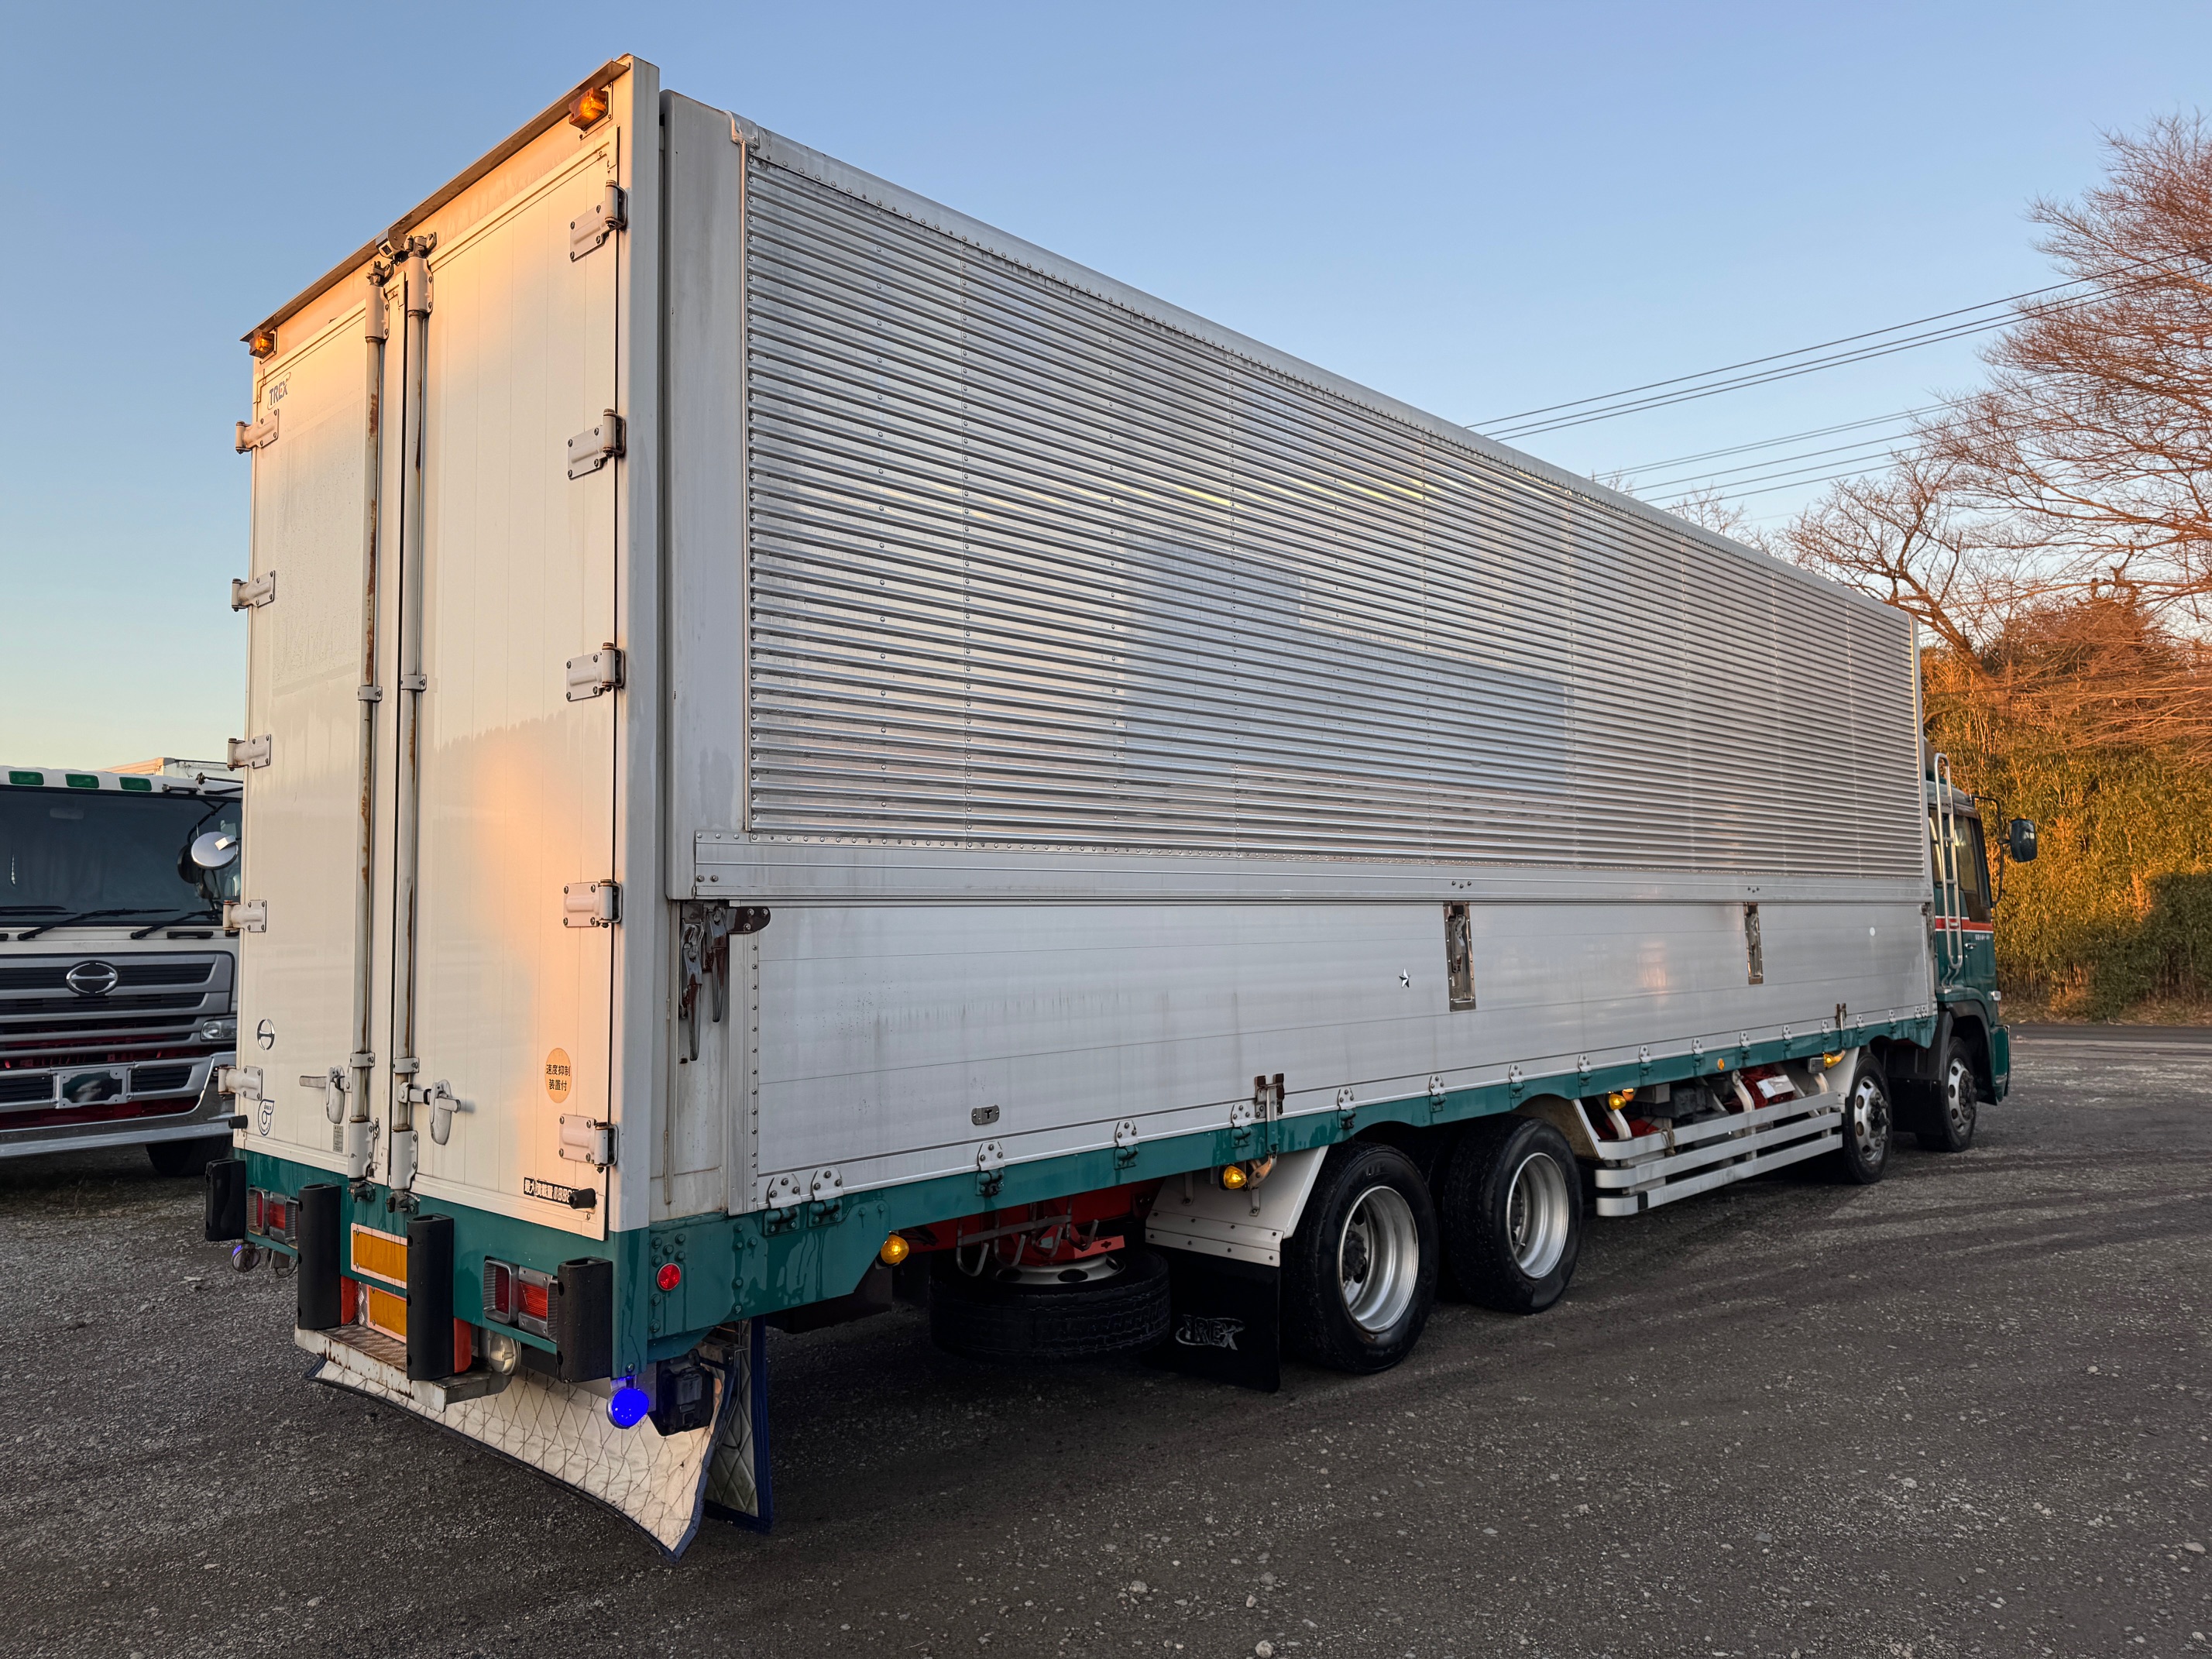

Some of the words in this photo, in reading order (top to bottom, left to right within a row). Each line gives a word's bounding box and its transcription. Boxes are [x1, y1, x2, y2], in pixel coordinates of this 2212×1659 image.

[269, 377, 288, 406] TREX
[546, 1063, 571, 1077] 速度抑制
[548, 1078, 567, 1091] 装置付
